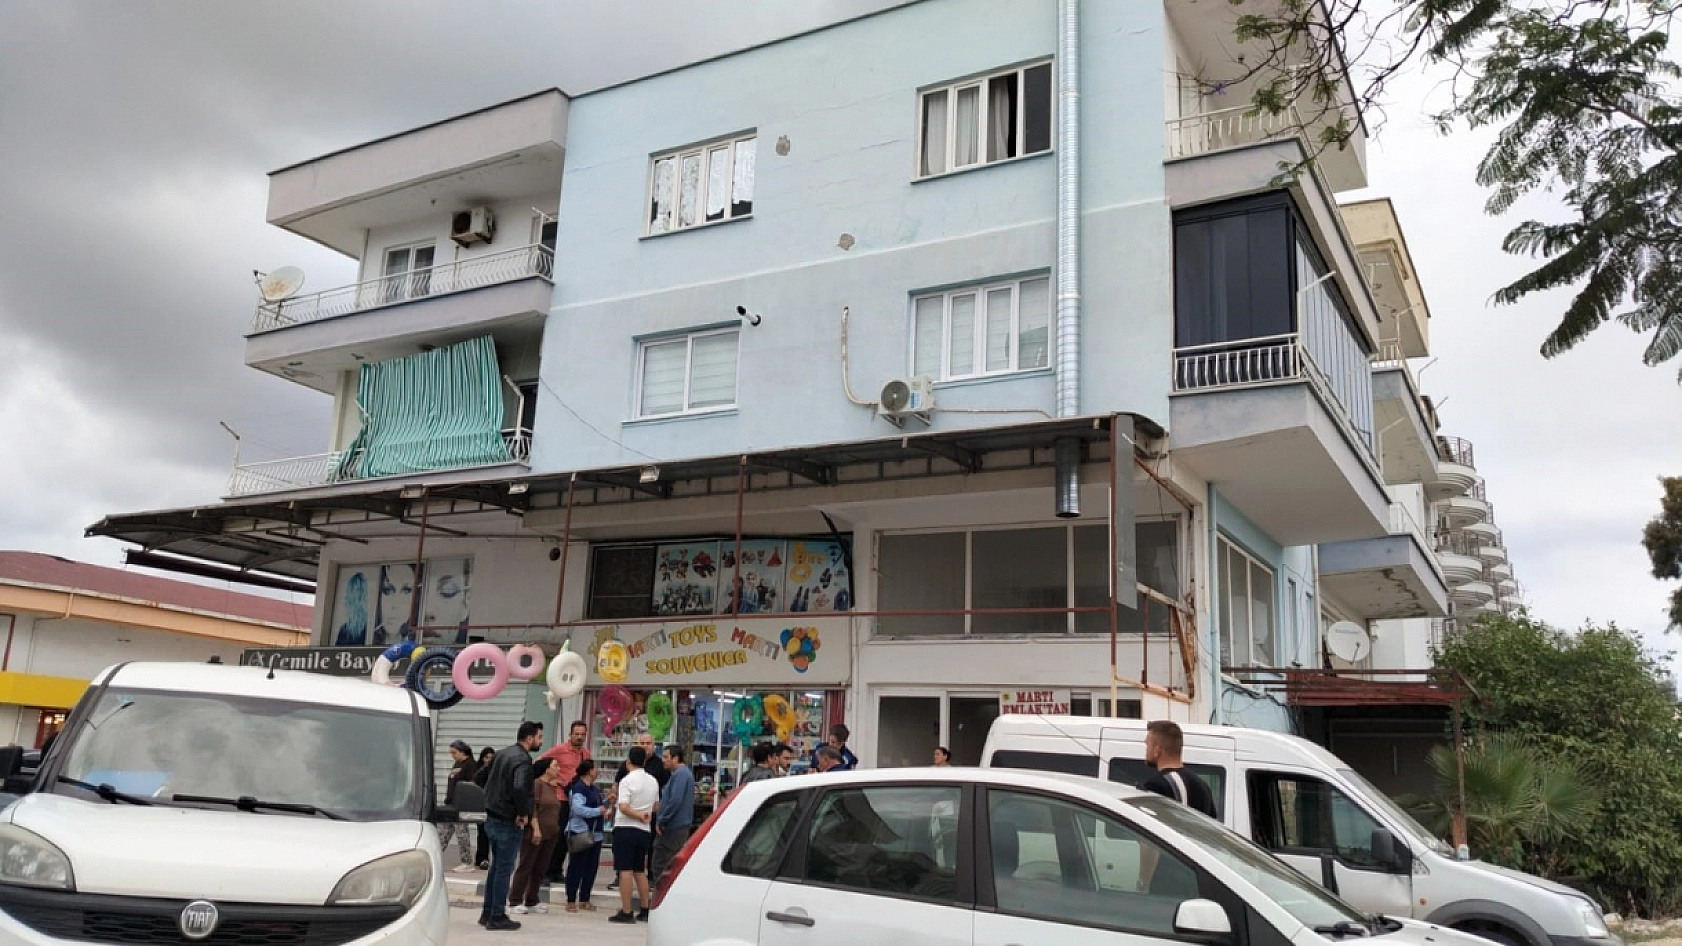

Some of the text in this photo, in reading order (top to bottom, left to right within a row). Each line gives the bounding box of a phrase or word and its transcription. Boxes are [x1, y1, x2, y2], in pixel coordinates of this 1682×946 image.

[669, 624, 718, 648] TOYS
[1016, 691, 1053, 702] MARTI
[188, 908, 212, 928] FIAT
